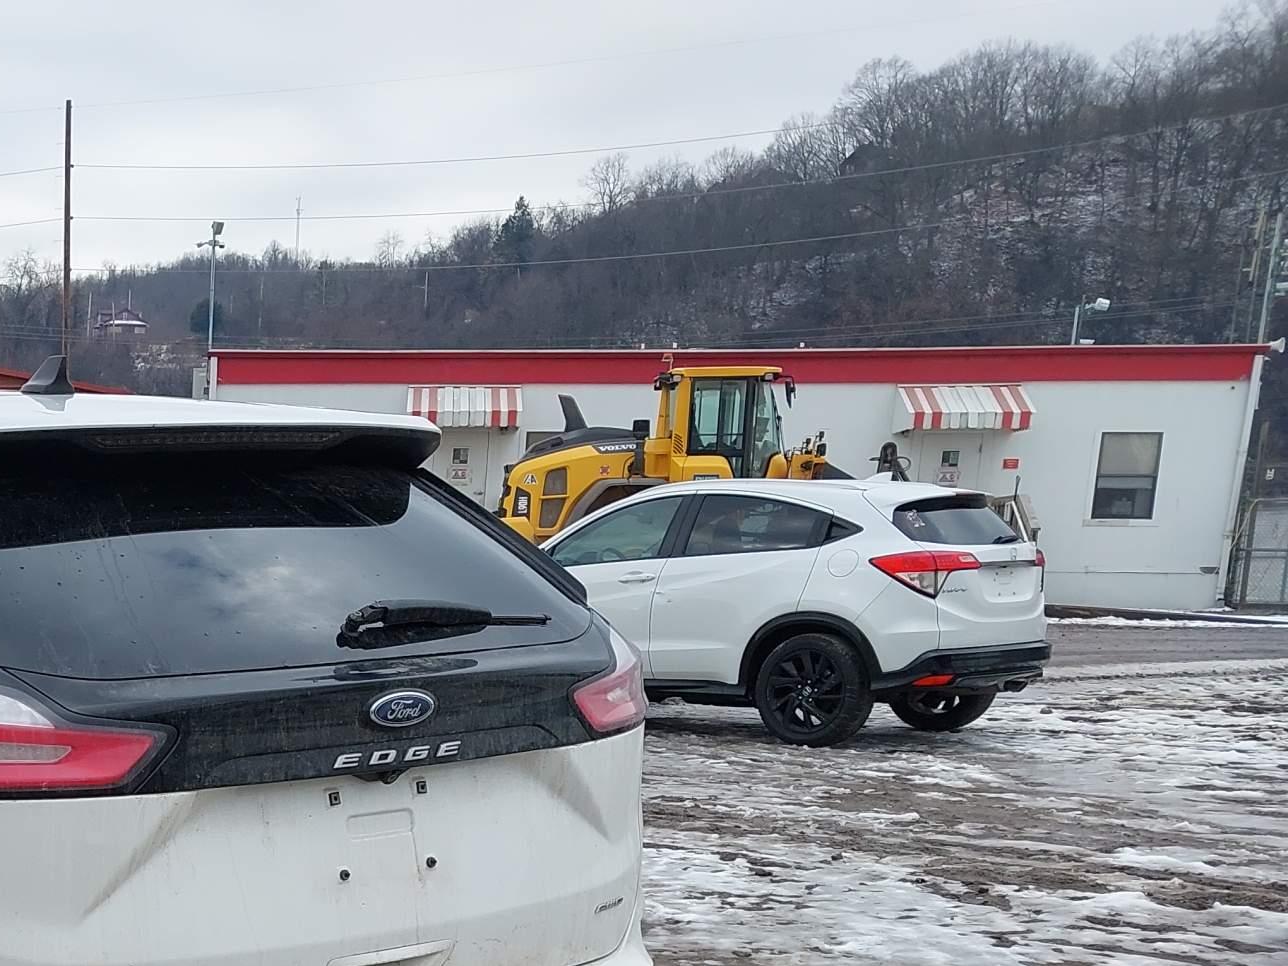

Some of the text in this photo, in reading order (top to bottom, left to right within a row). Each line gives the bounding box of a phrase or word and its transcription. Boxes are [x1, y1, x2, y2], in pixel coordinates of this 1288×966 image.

[598, 443, 637, 452] VOLVO
[387, 699, 422, 720] Ford
[333, 740, 462, 769] EDGE
